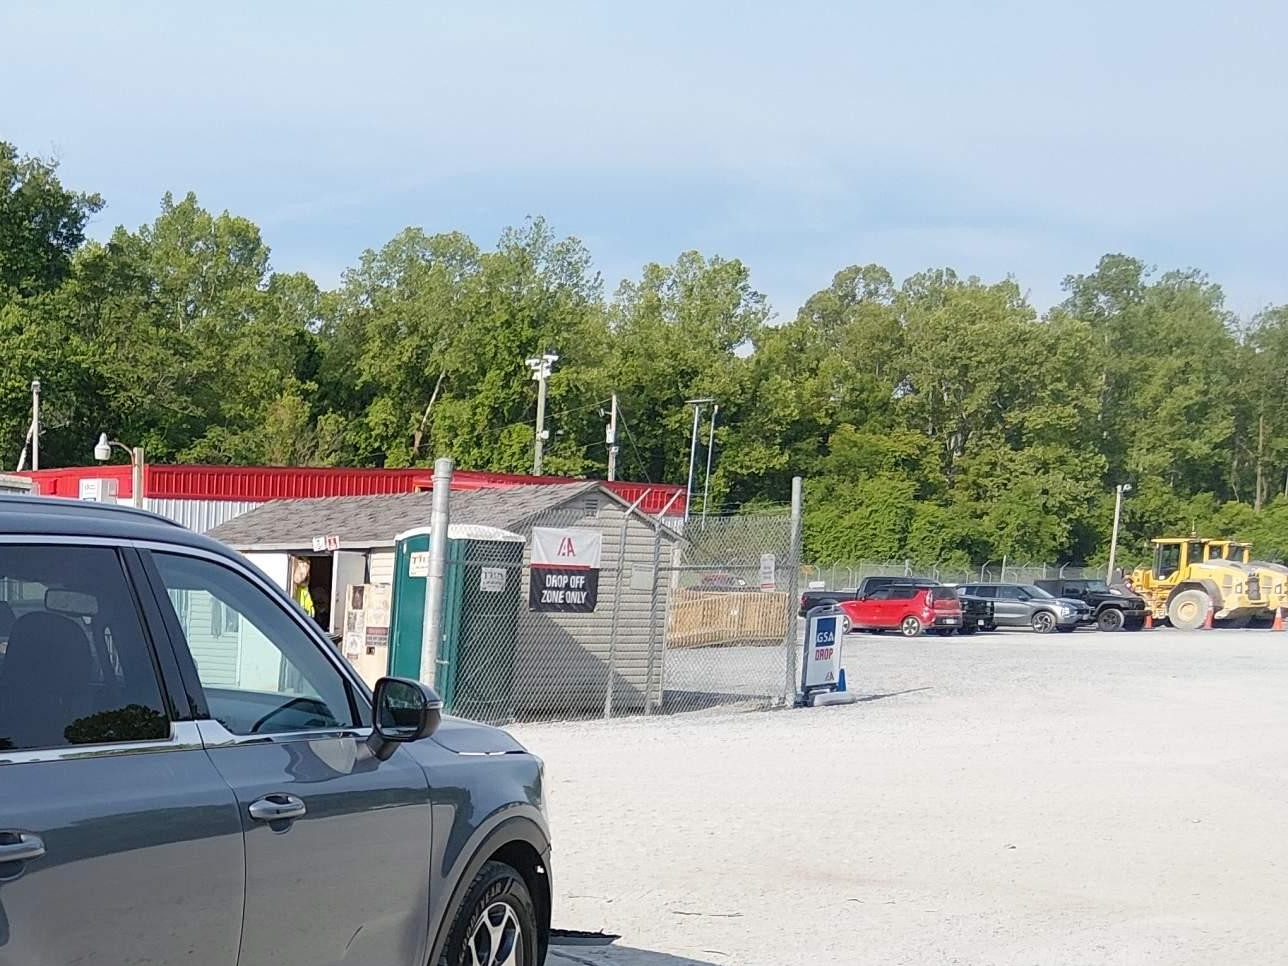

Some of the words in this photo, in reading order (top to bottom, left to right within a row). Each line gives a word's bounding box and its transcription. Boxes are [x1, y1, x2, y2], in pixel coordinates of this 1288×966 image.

[545, 574, 568, 588] DROP
[569, 576, 585, 589] OFF
[540, 590, 565, 604] ZONE
[565, 591, 587, 604] ONLY
[816, 631, 834, 643] GSA
[815, 648, 834, 661] DROP
